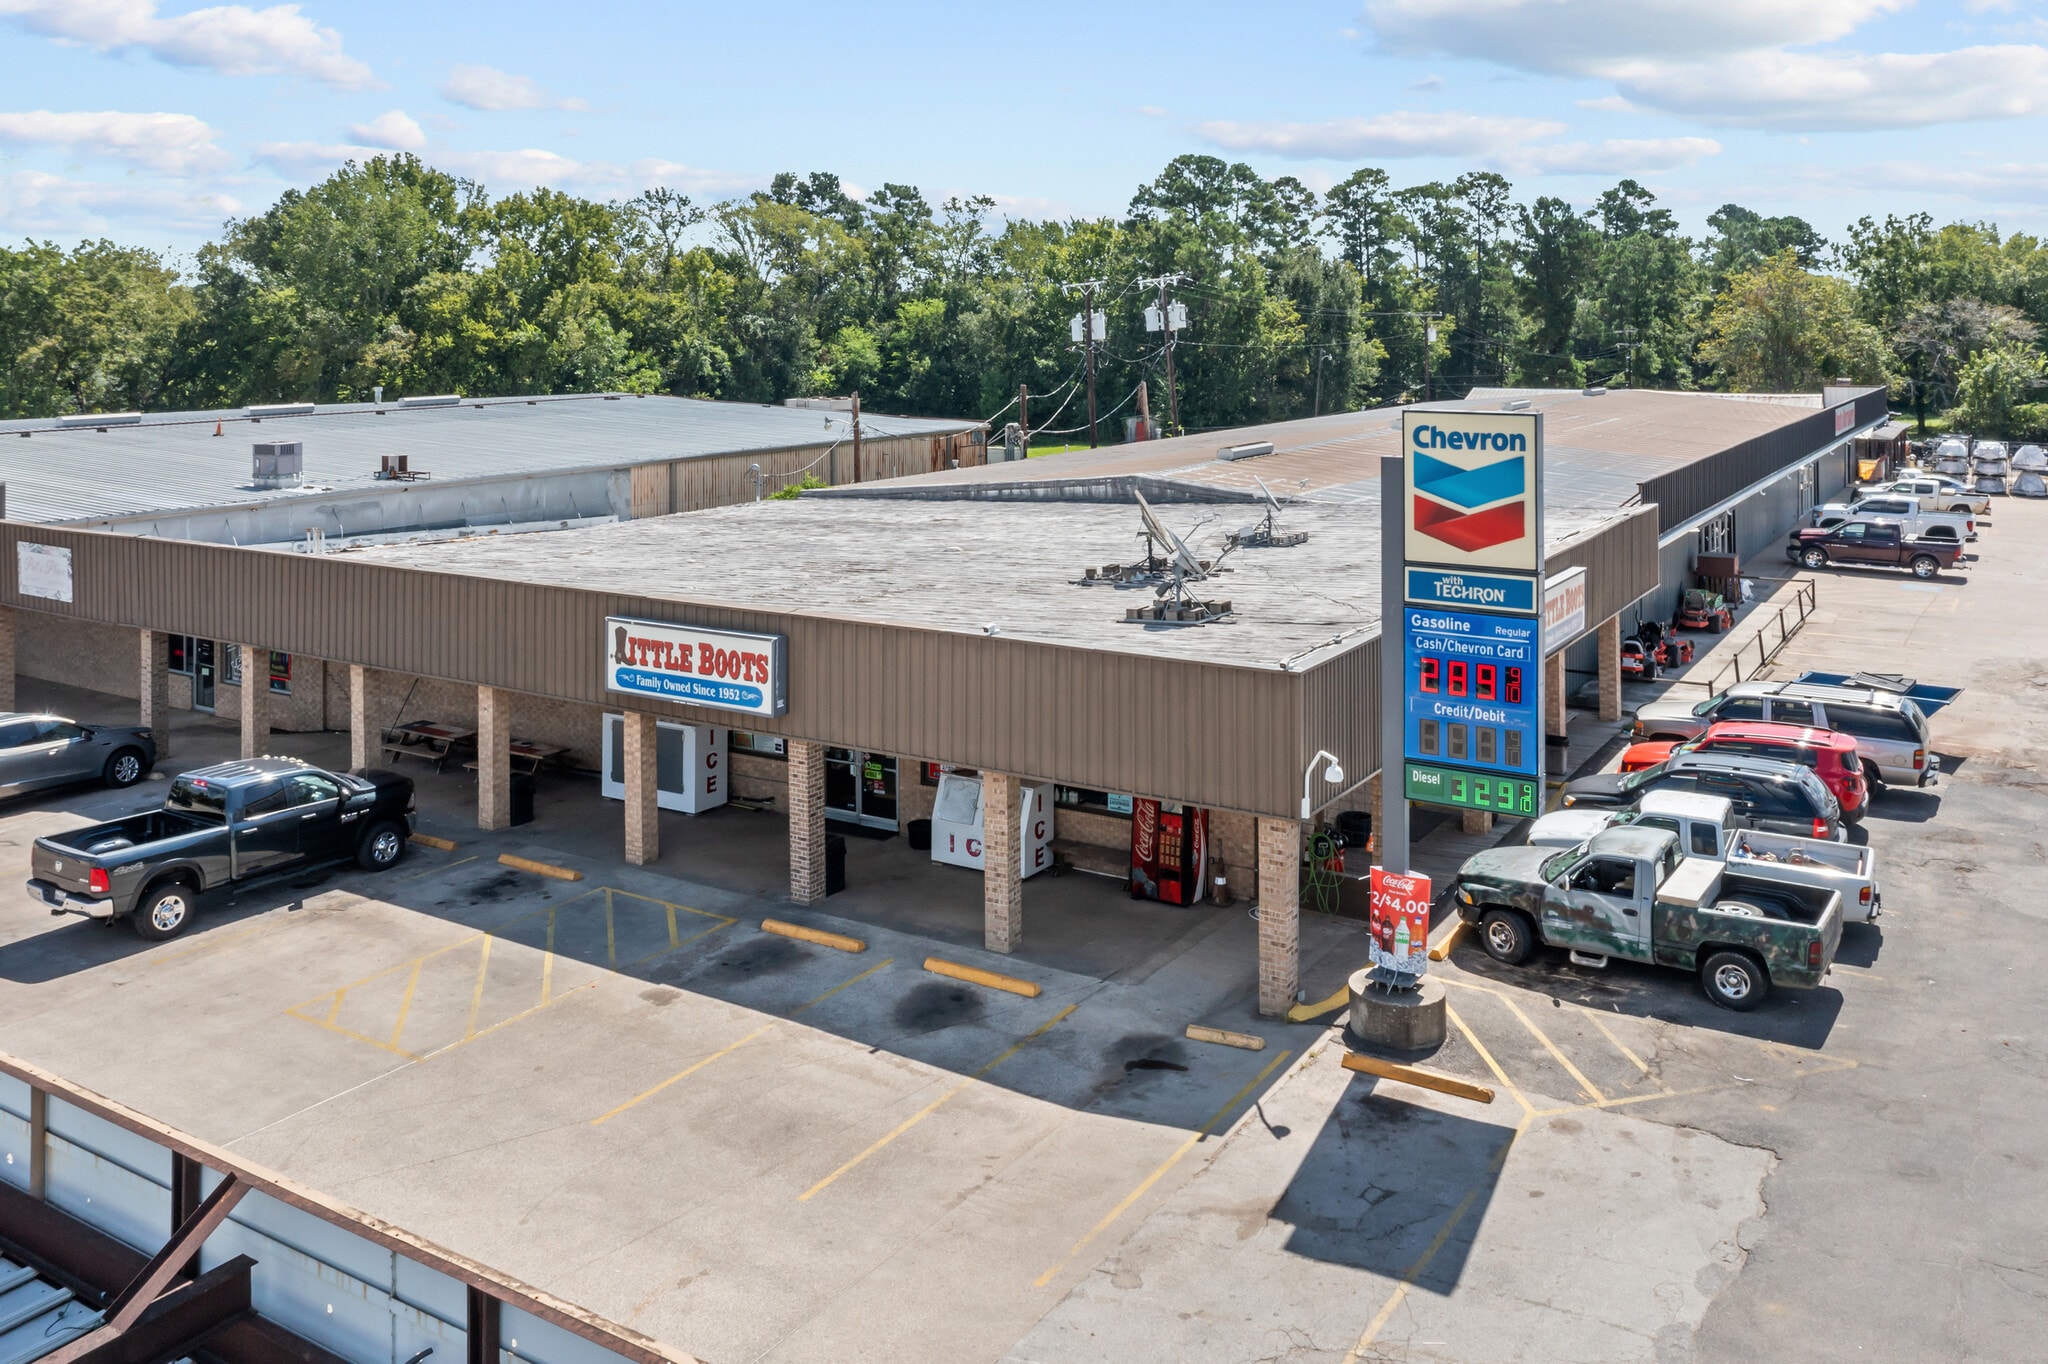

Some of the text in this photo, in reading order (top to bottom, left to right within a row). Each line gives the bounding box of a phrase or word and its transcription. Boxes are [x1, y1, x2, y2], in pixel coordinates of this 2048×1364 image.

[1412, 424, 1526, 452] Chevron
[1433, 581, 1505, 604] TECHRON
[1442, 576, 1464, 586] with
[1411, 614, 1471, 632] Gasoline
[1495, 626, 1531, 638] Regular
[1415, 636, 1524, 659] Cash/Chevron Card
[698, 642, 769, 685] BOOTS
[636, 674, 740, 701] Family Owned Since 1952
[1434, 702, 1506, 723] Credit/Debit
[706, 729, 718, 794] ICE
[1412, 770, 1441, 785] Diesel
[1034, 793, 1046, 868] ICE
[1135, 798, 1156, 862] Coca-Cola
[949, 833, 983, 858] IC
[1382, 875, 1416, 896] Coca-Cola
[1372, 891, 1428, 915] 2/$4.00
